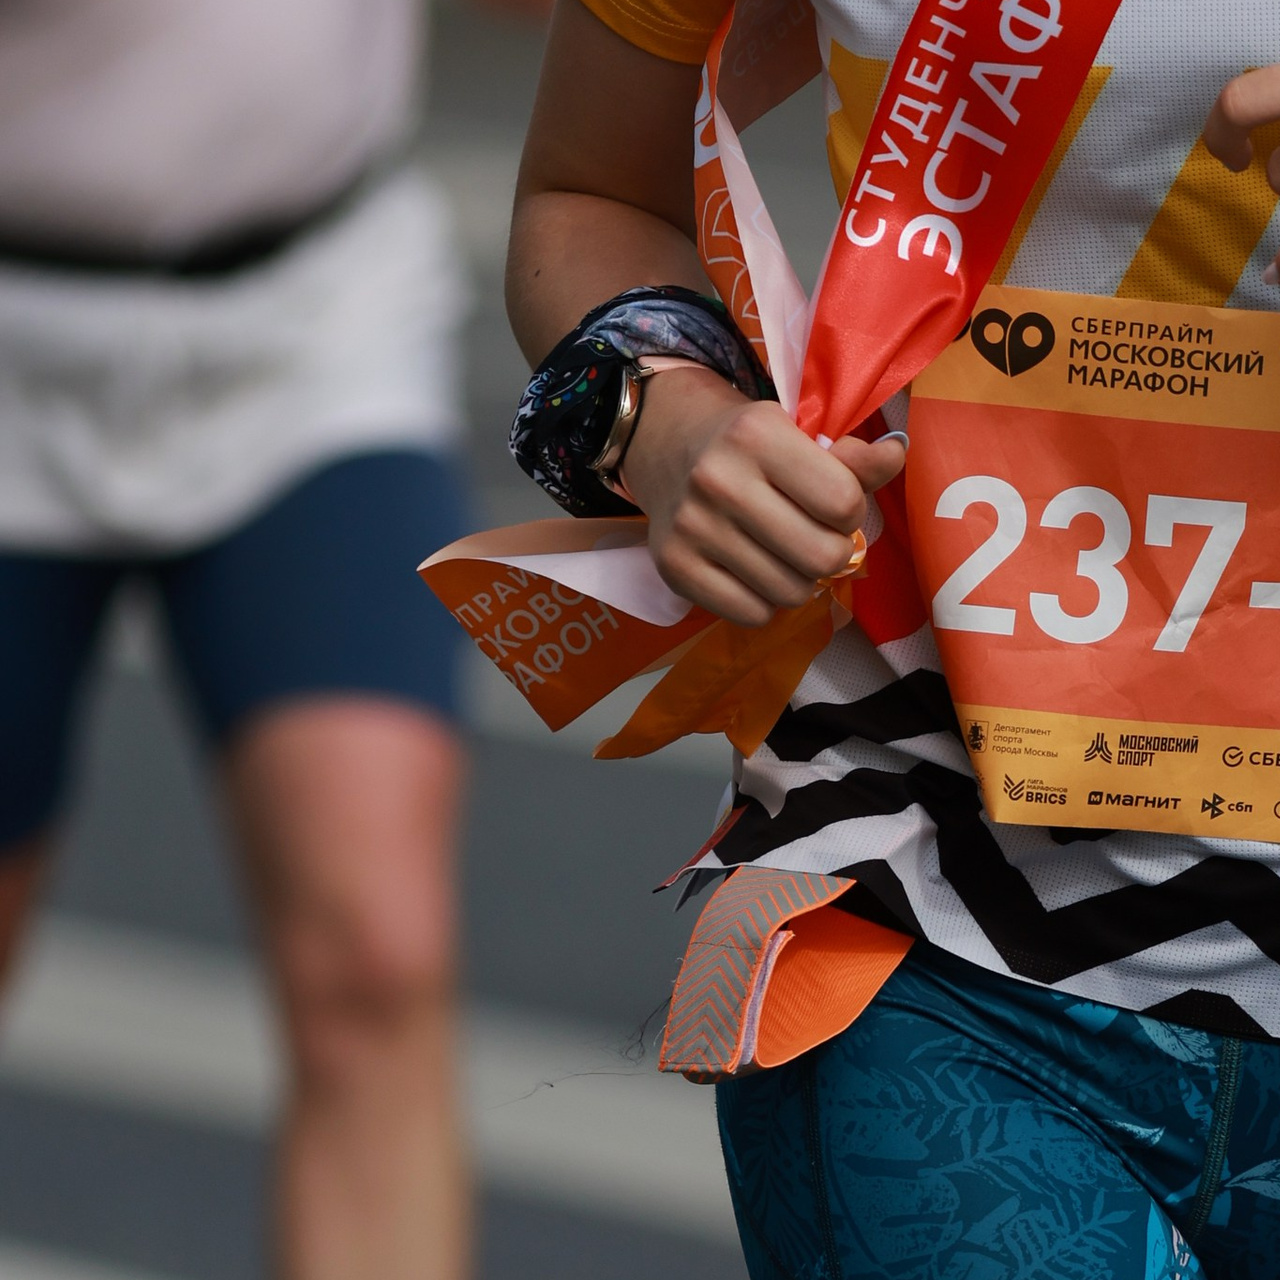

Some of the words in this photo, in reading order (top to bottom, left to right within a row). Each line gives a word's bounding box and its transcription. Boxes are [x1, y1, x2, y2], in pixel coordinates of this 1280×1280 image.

[1070, 316, 1214, 345] СБЕРПРАЙМ
[1068, 338, 1264, 376] МОСКОВСКИЙ
[1067, 364, 1209, 397] МАРАФОН
[451, 565, 539, 629] ПРАЙ
[993, 723, 1052, 737] Департамент
[992, 735, 1023, 746] спорта
[1118, 733, 1200, 754] МОСКОВСКИЙ
[991, 745, 1022, 756] города
[1023, 747, 1059, 759] Москвы
[1117, 751, 1155, 768] СПОРТ
[1025, 791, 1068, 806] BRICS
[1227, 800, 1253, 814] сбп
